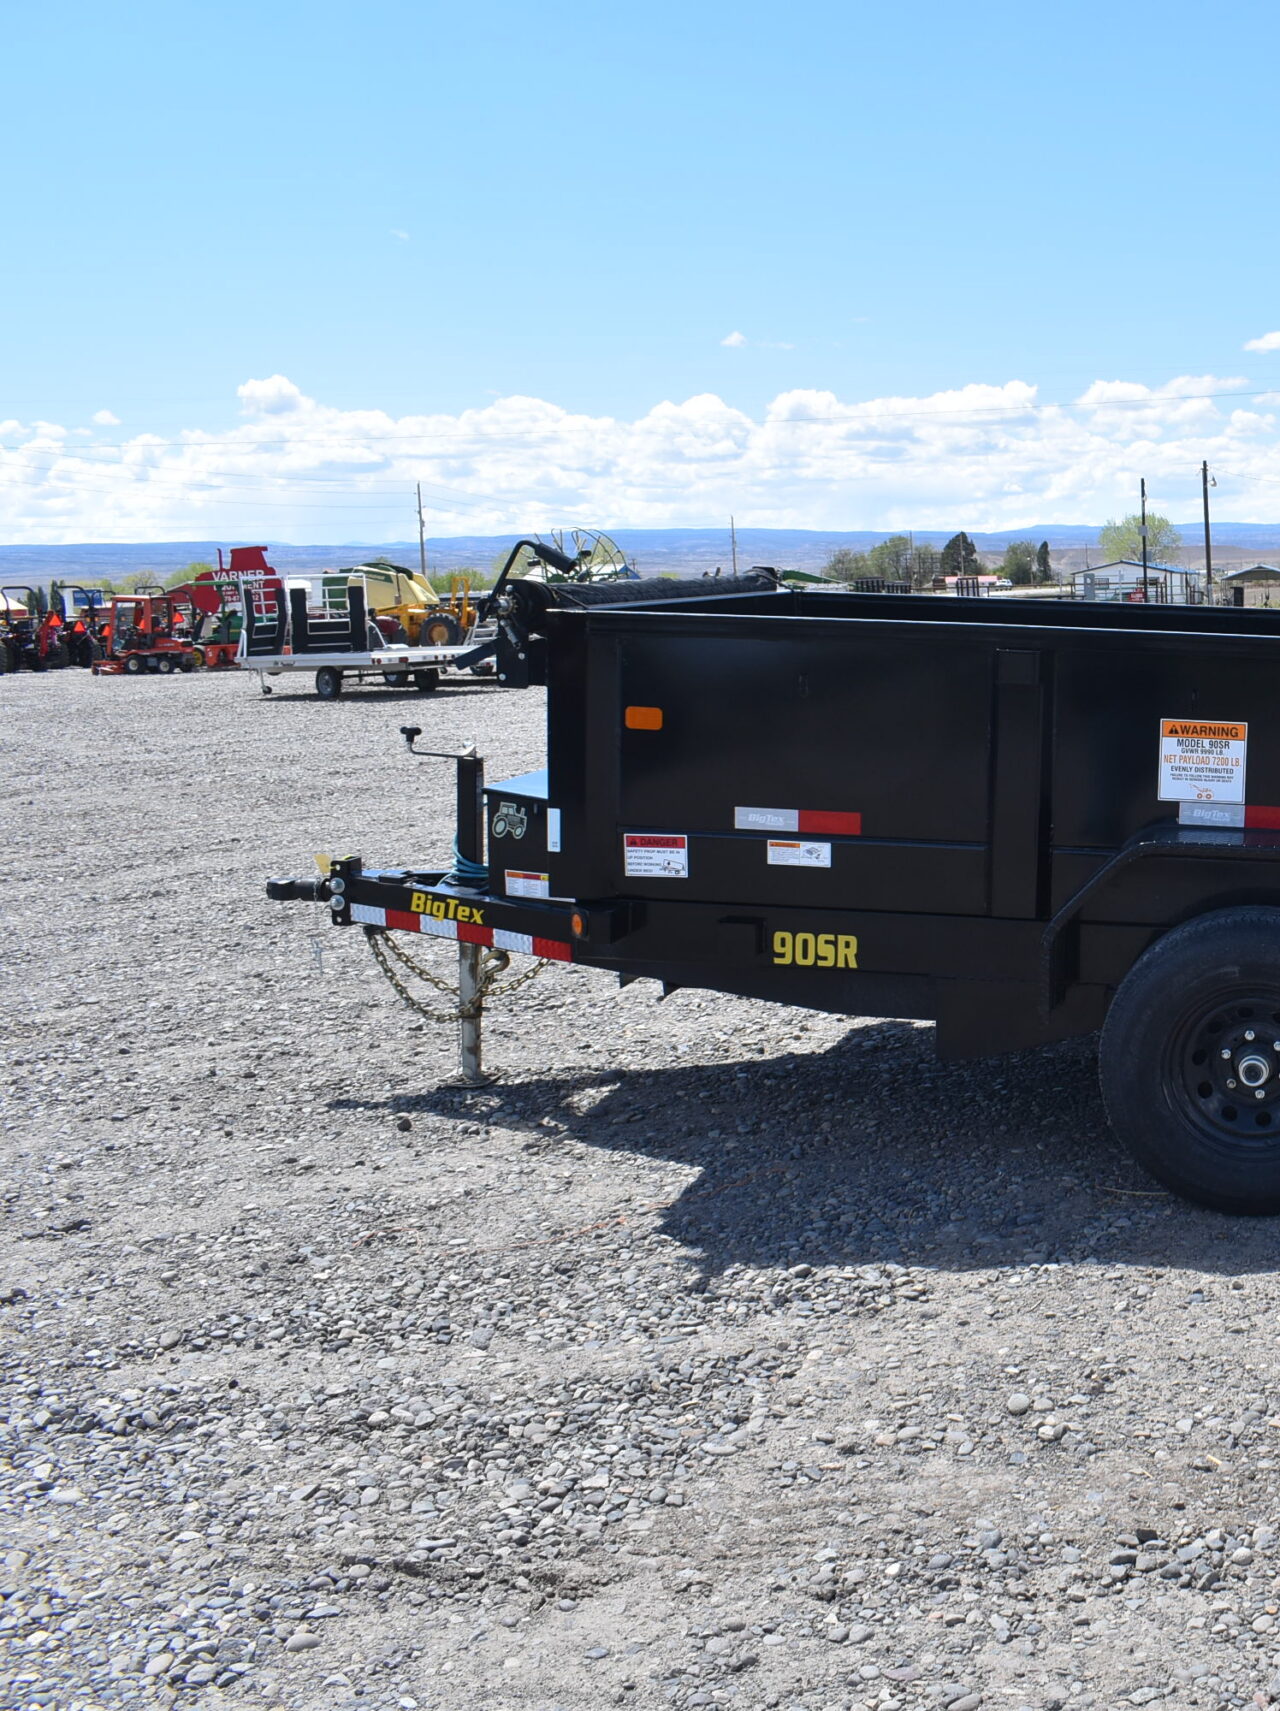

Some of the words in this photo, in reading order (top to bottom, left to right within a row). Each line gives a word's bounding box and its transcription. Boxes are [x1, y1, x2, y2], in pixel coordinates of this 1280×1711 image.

[212, 570, 264, 581] VARNER
[1180, 724, 1239, 737] WARNING
[1176, 738, 1206, 748] MODEL
[1208, 739, 1230, 749] 90SR
[1164, 754, 1177, 763] NET
[1179, 755, 1210, 765] PAYLOAD
[1212, 756, 1229, 766] 7200
[1194, 766, 1234, 774] DISTRIBUTED
[748, 813, 785, 823] BigTex
[1193, 809, 1232, 819] BigTex
[639, 838, 677, 846] DANGER
[410, 891, 485, 925] BigTex
[773, 931, 858, 968] 90SR
